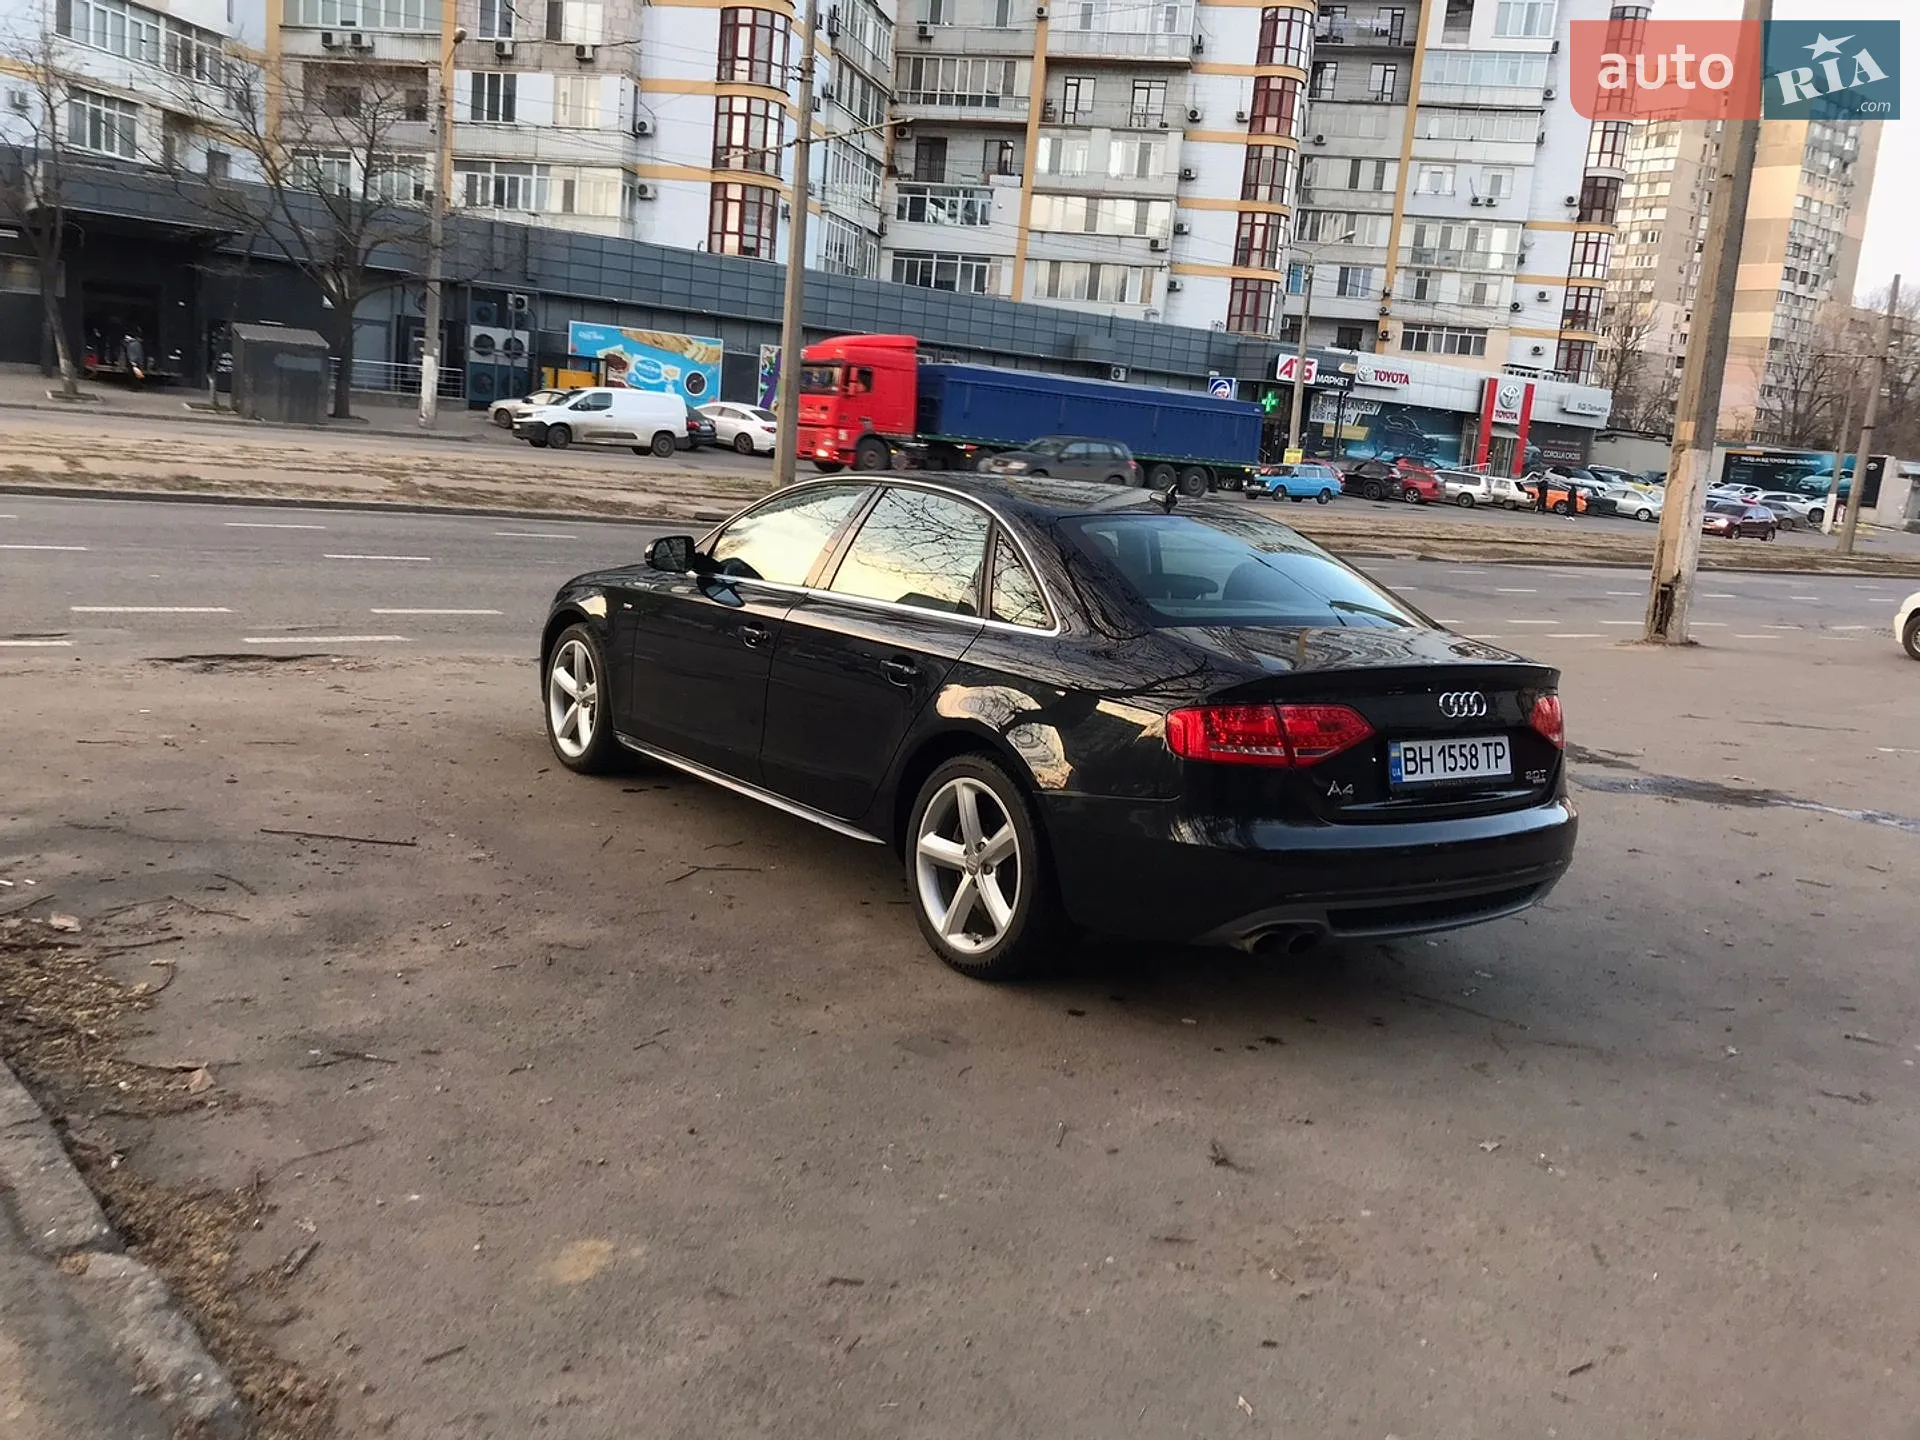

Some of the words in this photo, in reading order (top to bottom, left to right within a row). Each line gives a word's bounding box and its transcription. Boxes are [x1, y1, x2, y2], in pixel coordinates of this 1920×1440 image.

[1374, 368, 1410, 385] TOYOTA
[1495, 409, 1518, 420] TOYOTA
[1403, 746, 1434, 775] BH
[1438, 743, 1479, 772] 1558
[1482, 741, 1506, 769] TP
[1326, 779, 1354, 797] A4
